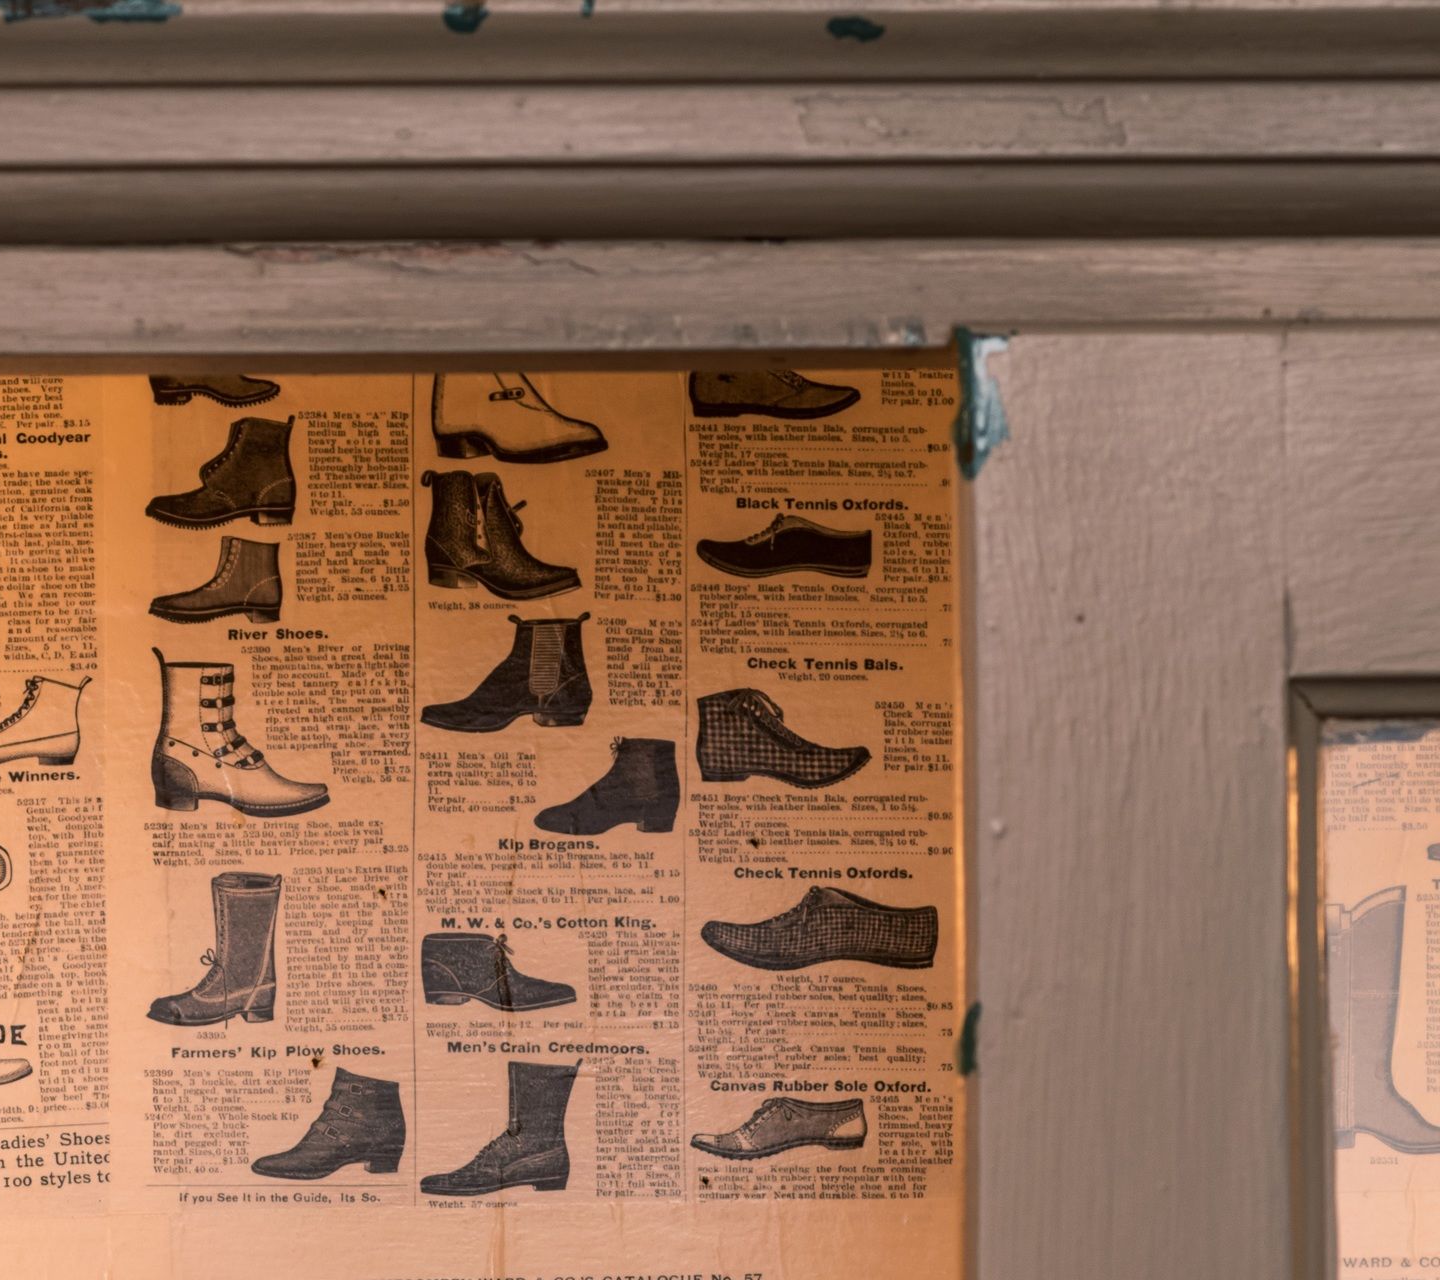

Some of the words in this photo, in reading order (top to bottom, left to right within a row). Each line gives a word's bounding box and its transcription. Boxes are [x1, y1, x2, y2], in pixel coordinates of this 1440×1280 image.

[16, 431, 91, 446] Goodyear
[736, 497, 780, 510] Black
[783, 497, 839, 511] Tennis
[842, 498, 909, 511] Oxfords.
[228, 628, 268, 641] River
[275, 628, 329, 640] Shoes.
